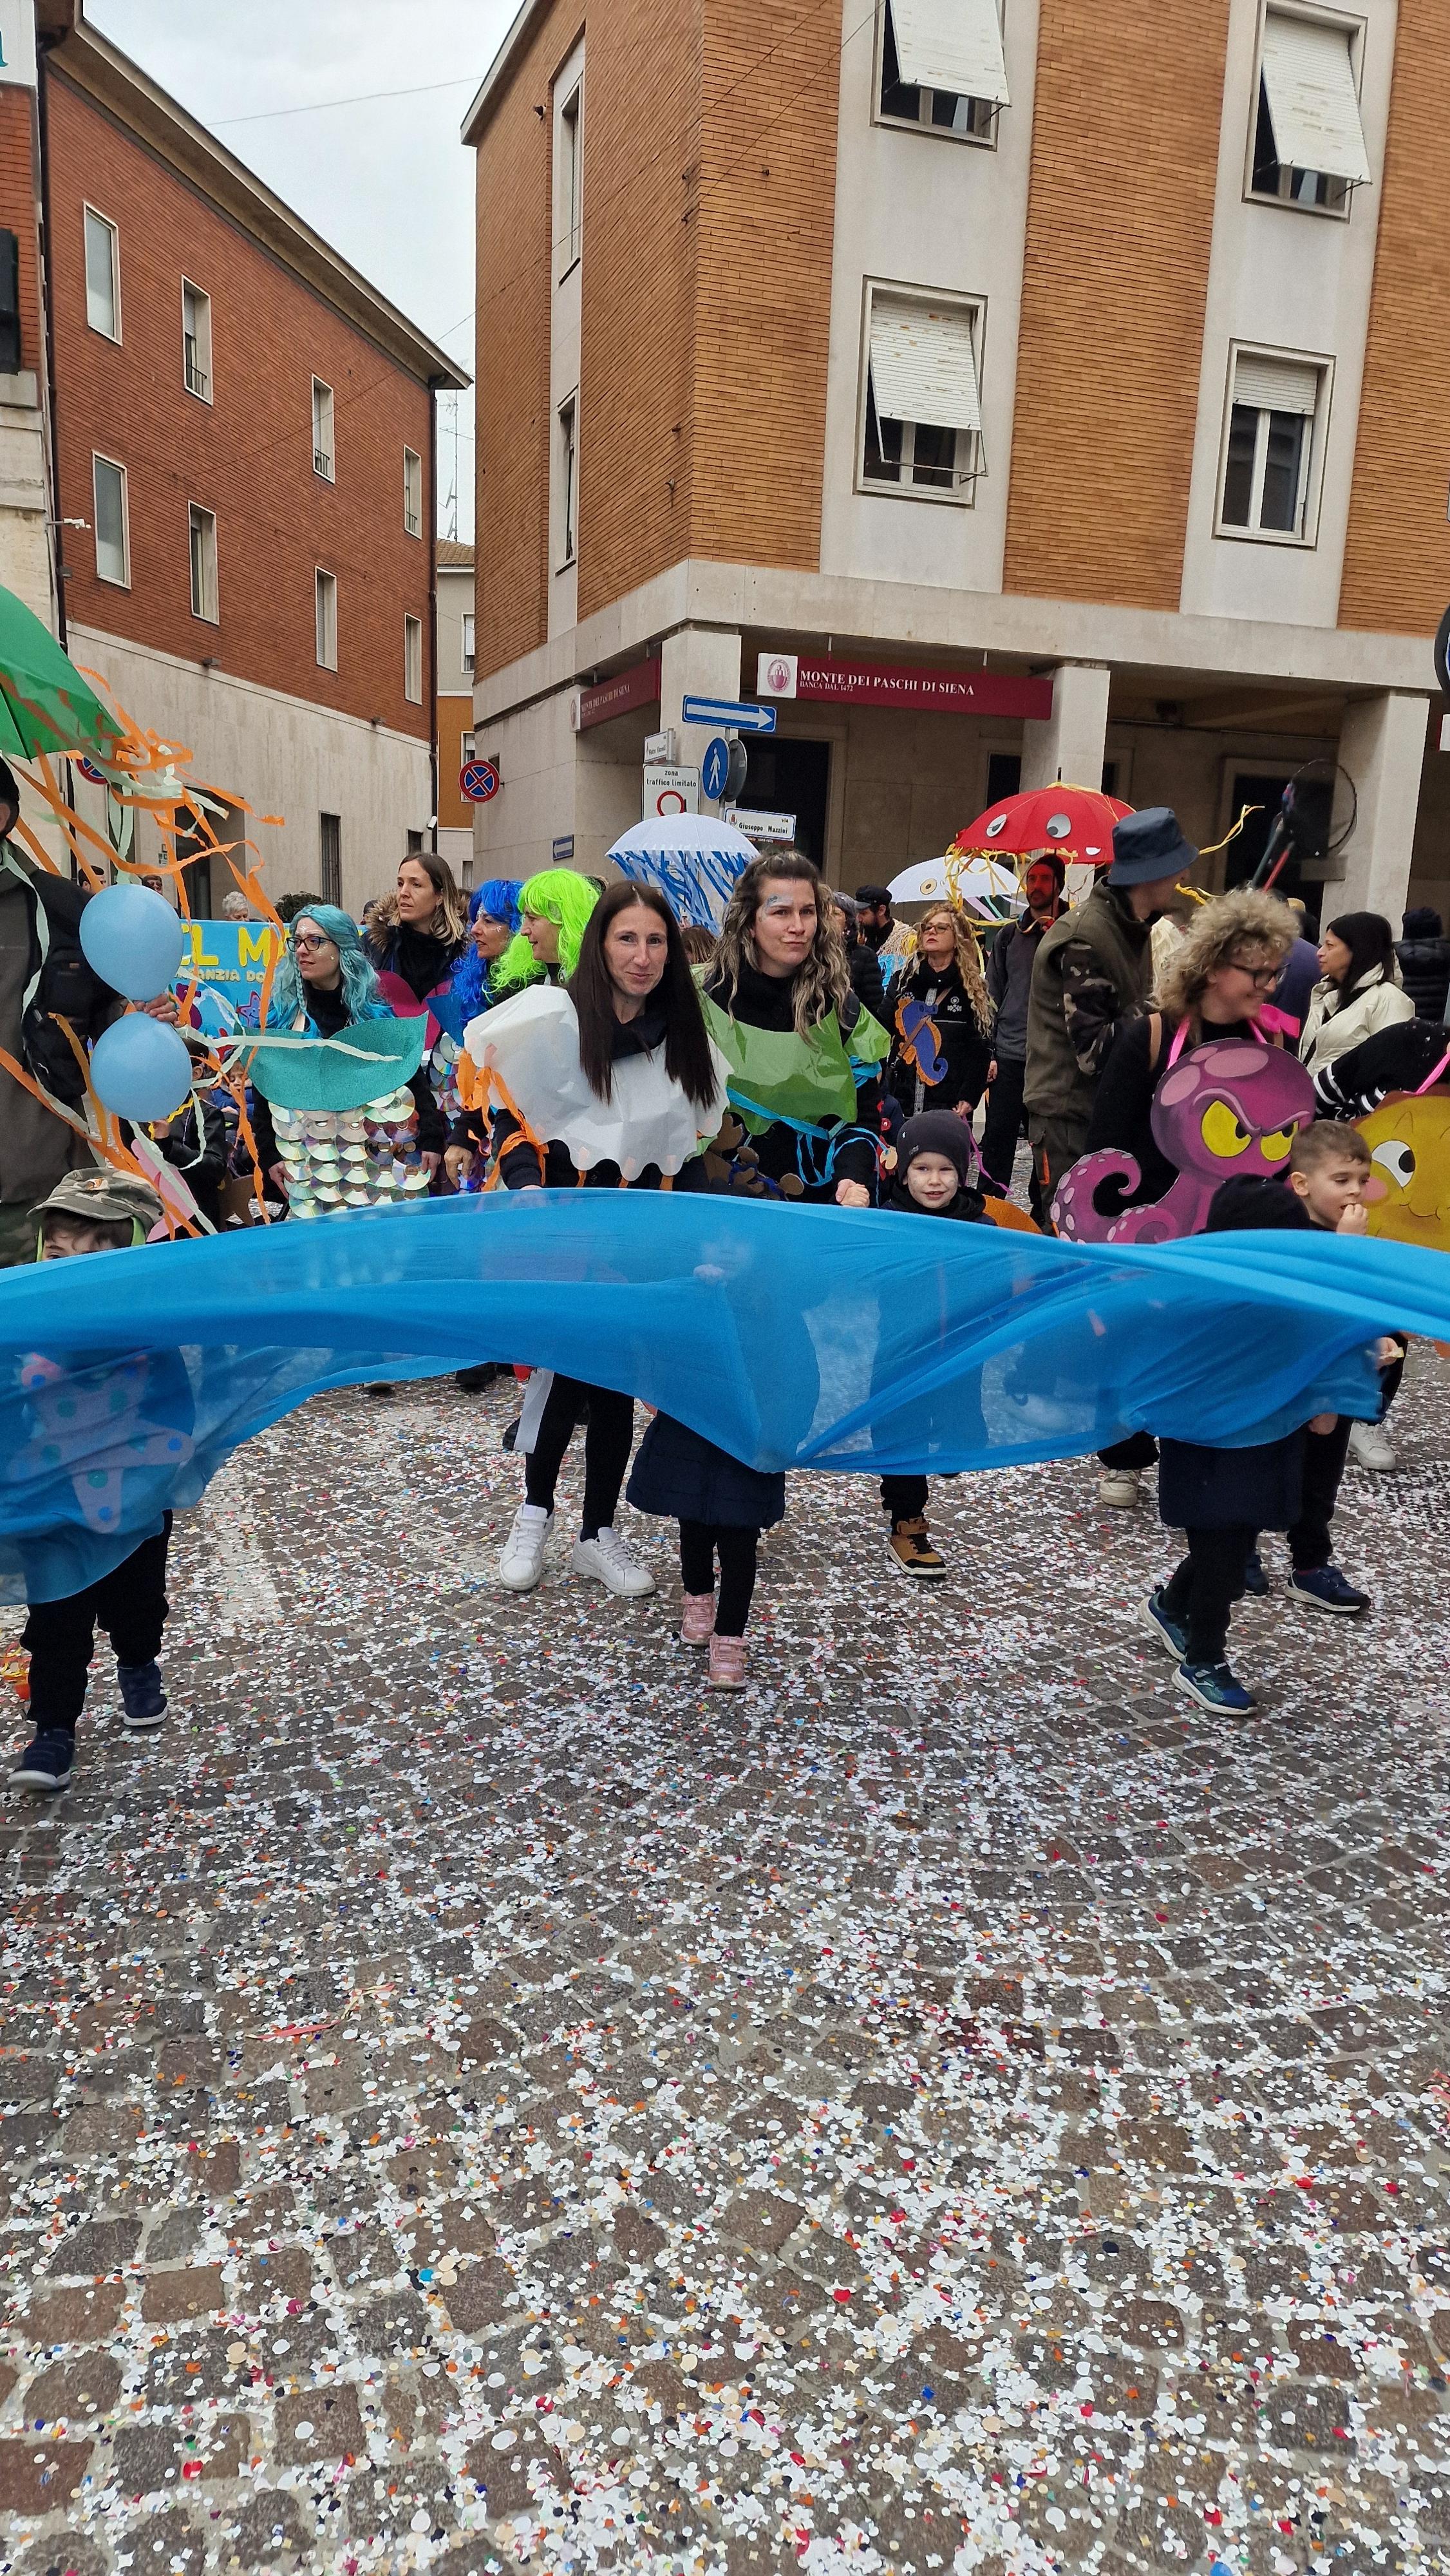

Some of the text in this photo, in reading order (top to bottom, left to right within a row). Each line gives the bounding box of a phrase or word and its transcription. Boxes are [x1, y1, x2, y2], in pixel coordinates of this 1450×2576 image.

[800, 670, 974, 696] MONTE DEI PASCHI DI SIENA
[800, 681, 823, 689] BANCA
[646, 778, 697, 788] traffico limitato
[739, 822, 788, 834] Giuseppe Mazzini
